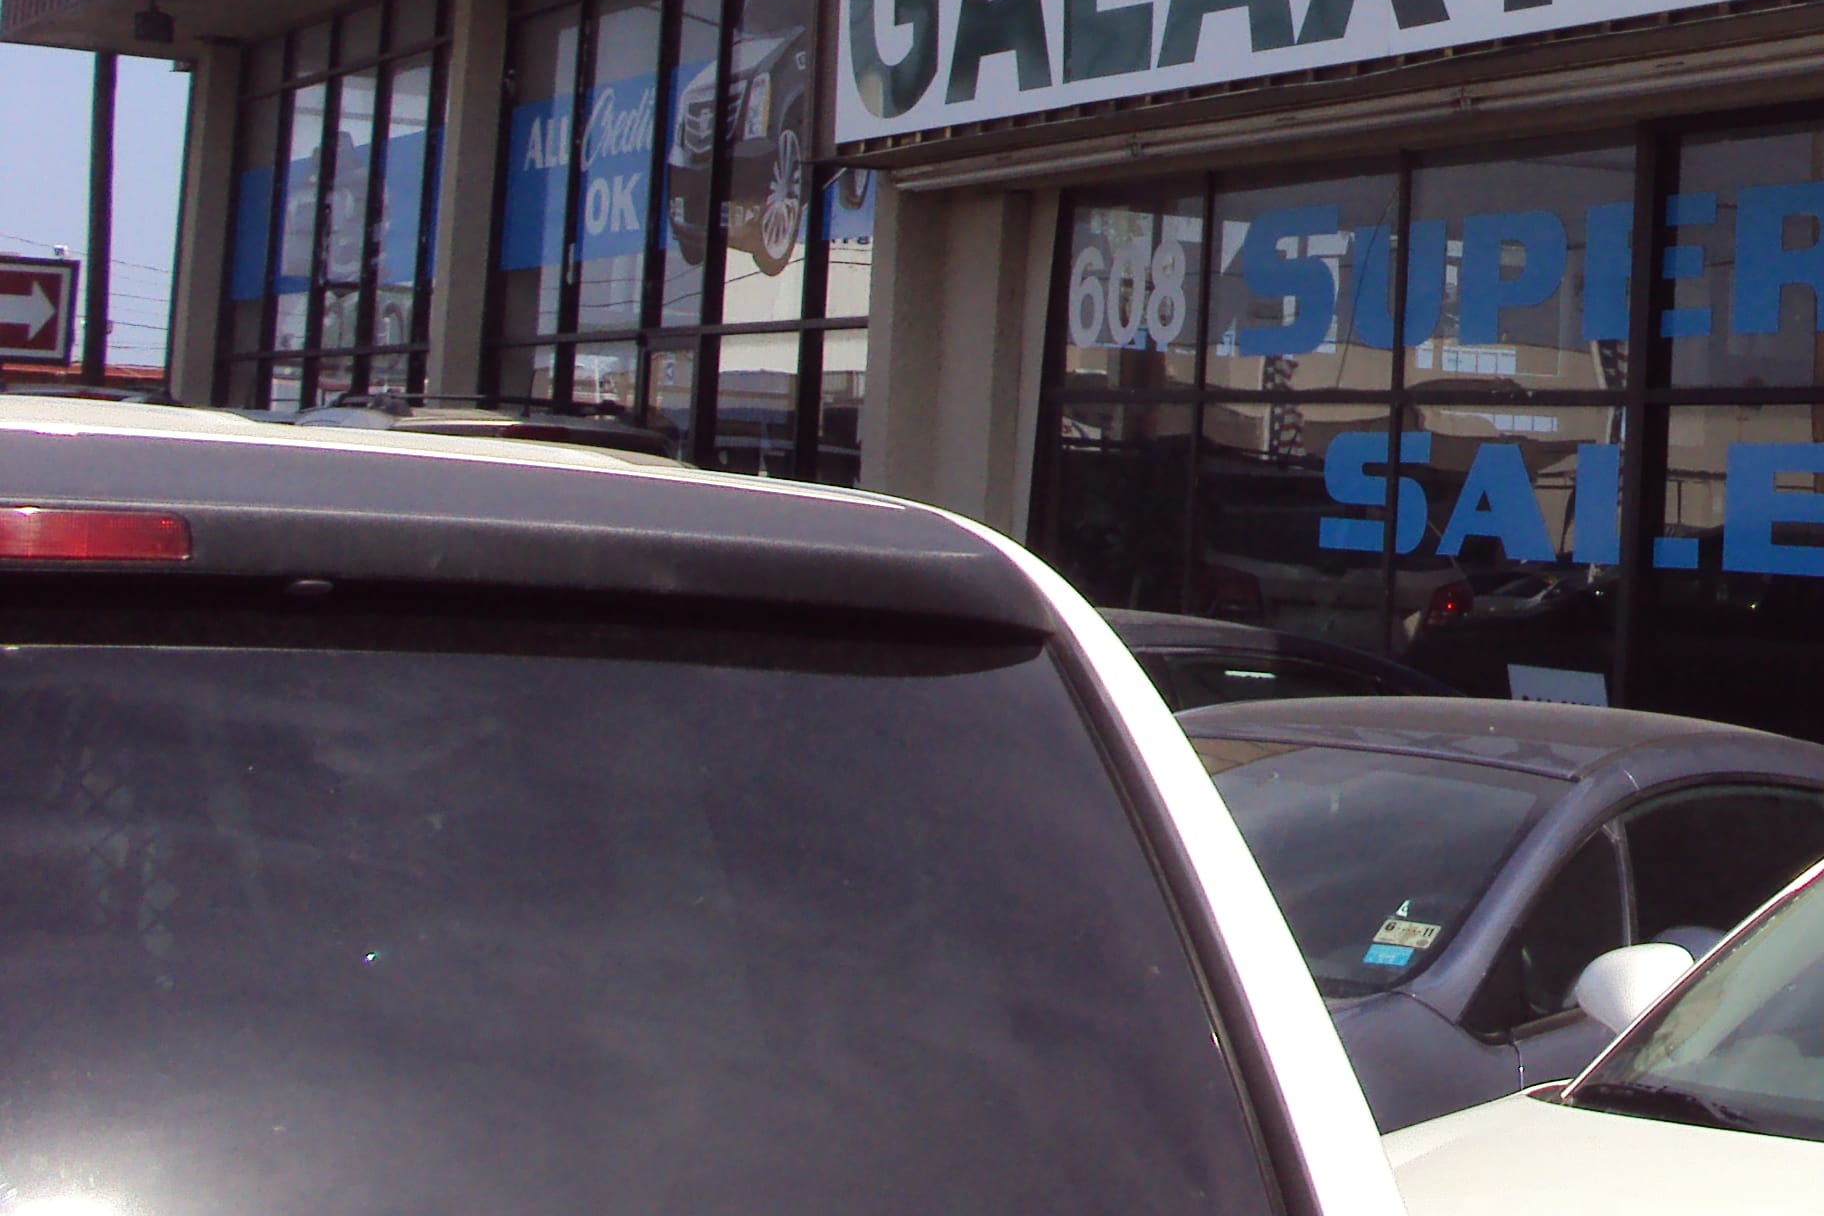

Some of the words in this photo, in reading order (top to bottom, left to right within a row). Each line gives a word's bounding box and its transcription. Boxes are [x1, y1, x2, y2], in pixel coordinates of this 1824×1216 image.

[524, 116, 570, 172] ALL
[579, 87, 656, 173] Credi
[585, 171, 641, 236] OK
[1068, 239, 1186, 348] 608
